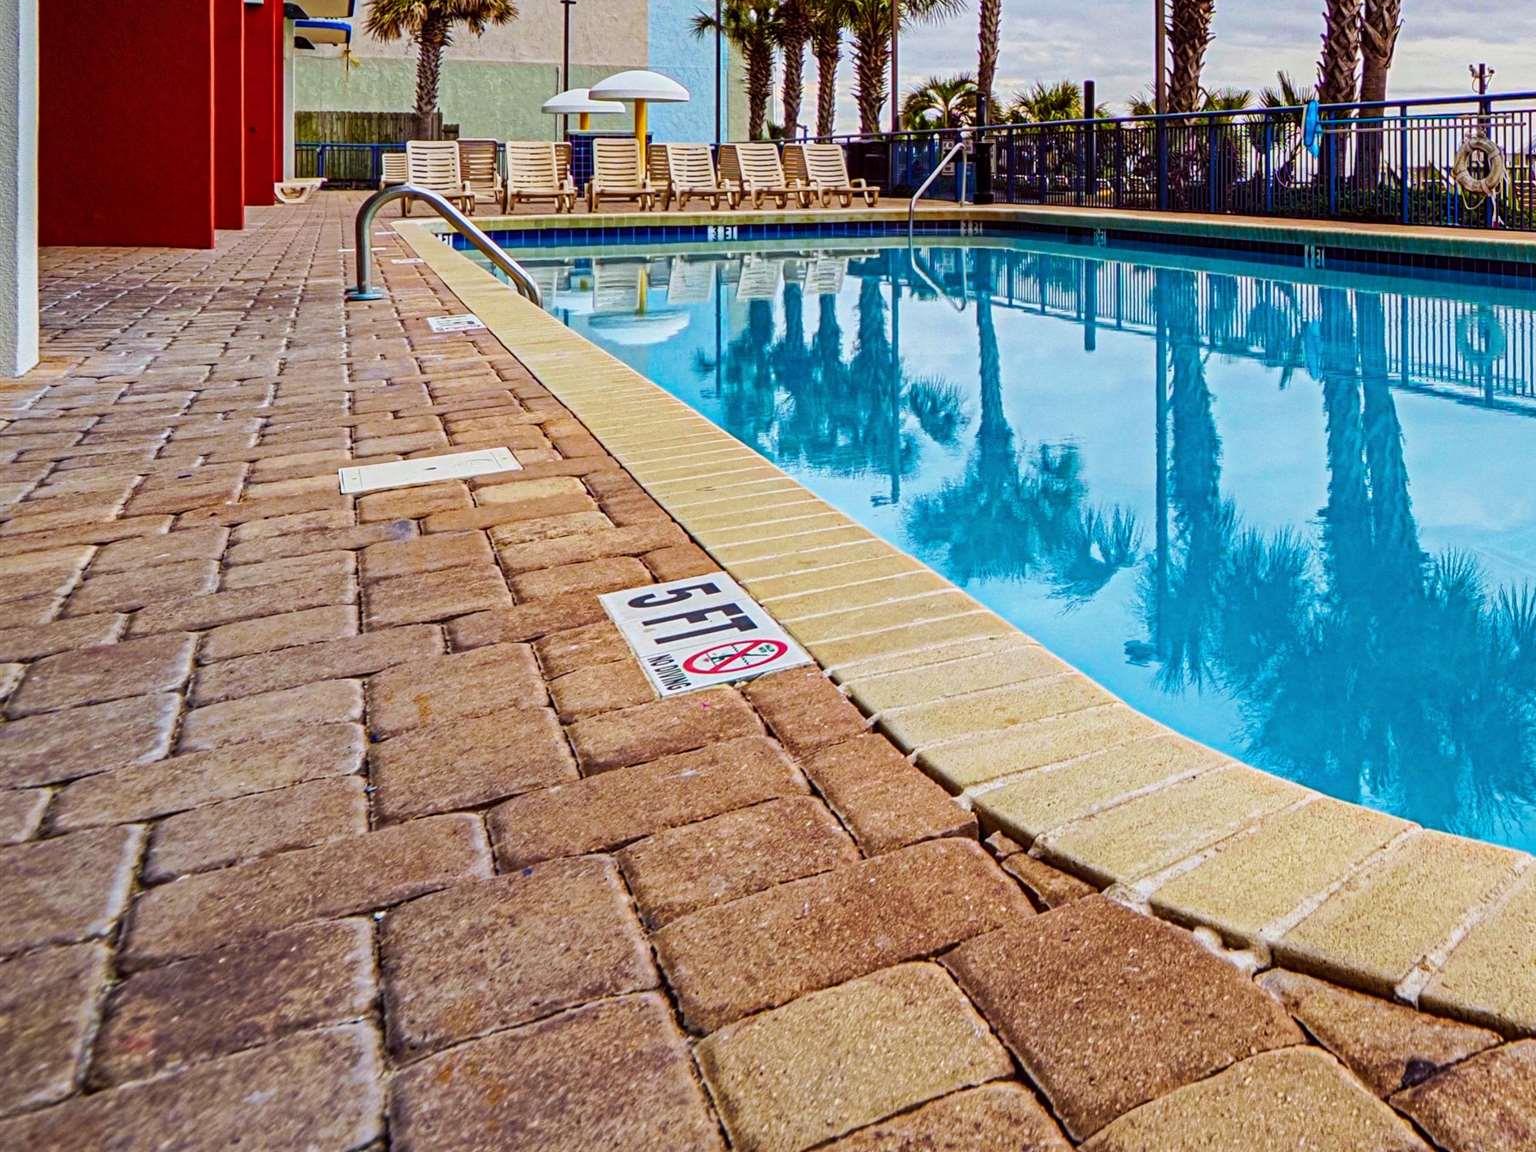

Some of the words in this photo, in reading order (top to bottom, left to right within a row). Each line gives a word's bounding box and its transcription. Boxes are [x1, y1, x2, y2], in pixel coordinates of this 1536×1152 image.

[627, 582, 722, 609] 5
[641, 602, 758, 645] FT
[647, 653, 675, 667] NO
[654, 664, 692, 691] DIVING
